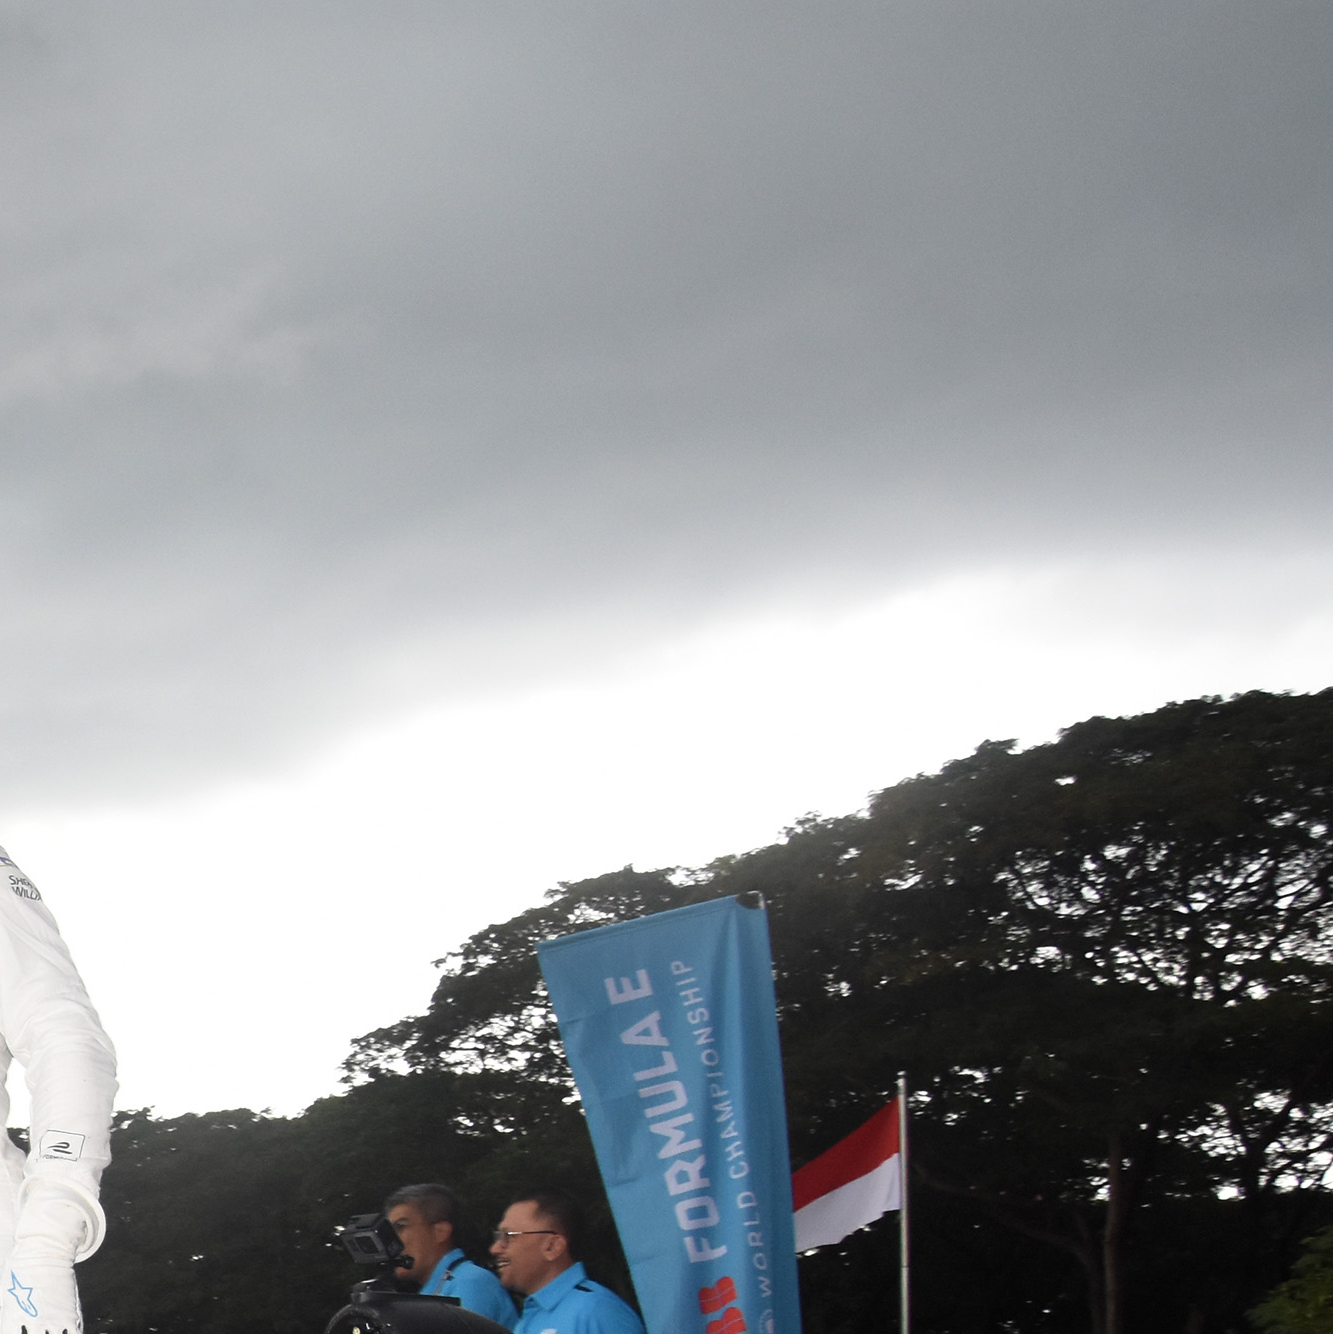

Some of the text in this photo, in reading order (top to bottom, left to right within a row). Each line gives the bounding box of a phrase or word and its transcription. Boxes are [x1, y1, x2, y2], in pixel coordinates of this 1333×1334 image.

[604, 968, 653, 1006] E
[620, 1010, 727, 1264] FORMULA
[670, 960, 773, 1298] WORLD CHAMPIONSHIP
